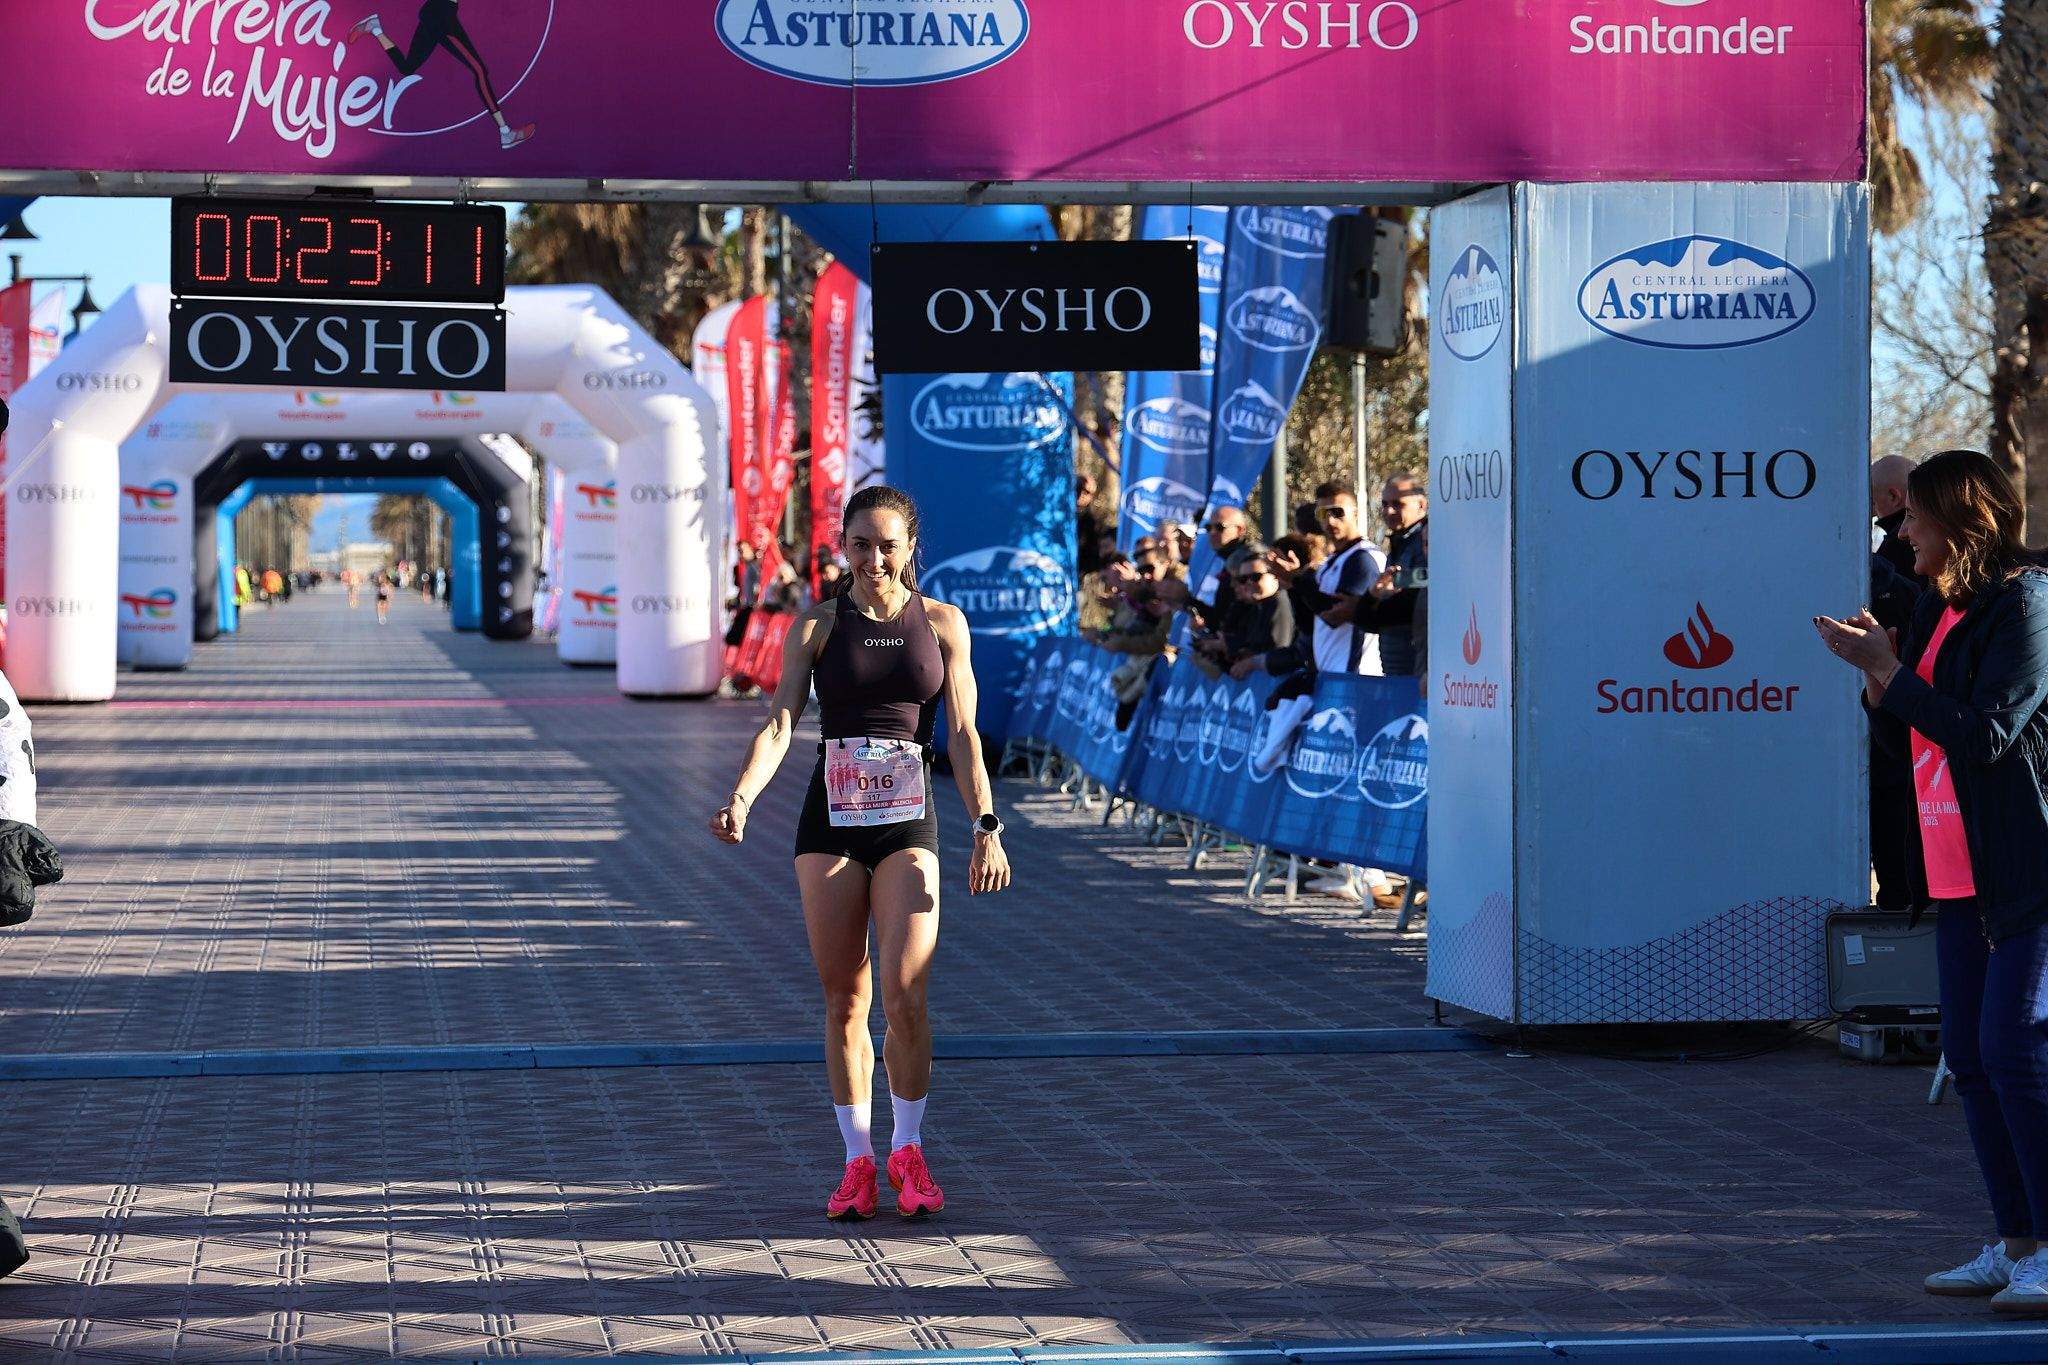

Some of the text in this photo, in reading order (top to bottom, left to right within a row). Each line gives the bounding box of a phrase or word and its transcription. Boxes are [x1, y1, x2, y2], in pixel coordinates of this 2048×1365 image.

[84, 0, 331, 47] Carrera
[740, 0, 1005, 47] ASTURIANA
[1183, 1, 1418, 50] OYSHO
[1569, 15, 1793, 55] Santander
[145, 41, 423, 158] de la Mujer
[195, 213, 481, 286] 00:23:11
[1596, 277, 1797, 320] ASTURIANA
[1632, 275, 1790, 287] CENTRAL LECHERA
[927, 287, 1151, 333] OYSHO
[1445, 293, 1502, 335] ASTURIANA
[187, 311, 490, 379] OYSHO
[57, 371, 142, 392] OYSHO
[583, 370, 667, 391] OYSHO
[261, 441, 431, 461] VOLVO
[16, 482, 94, 504] OYSH
[1439, 450, 1503, 503] OYSHO
[1571, 449, 1816, 500] OYSHO
[14, 595, 94, 617] OYSH
[864, 637, 904, 647] OYSHO
[1443, 672, 1499, 709] Santander
[1597, 678, 1800, 713] Santander
[840, 813, 868, 822] OYSHO
[886, 810, 915, 819] Santander
[1920, 801, 1930, 814] DE
